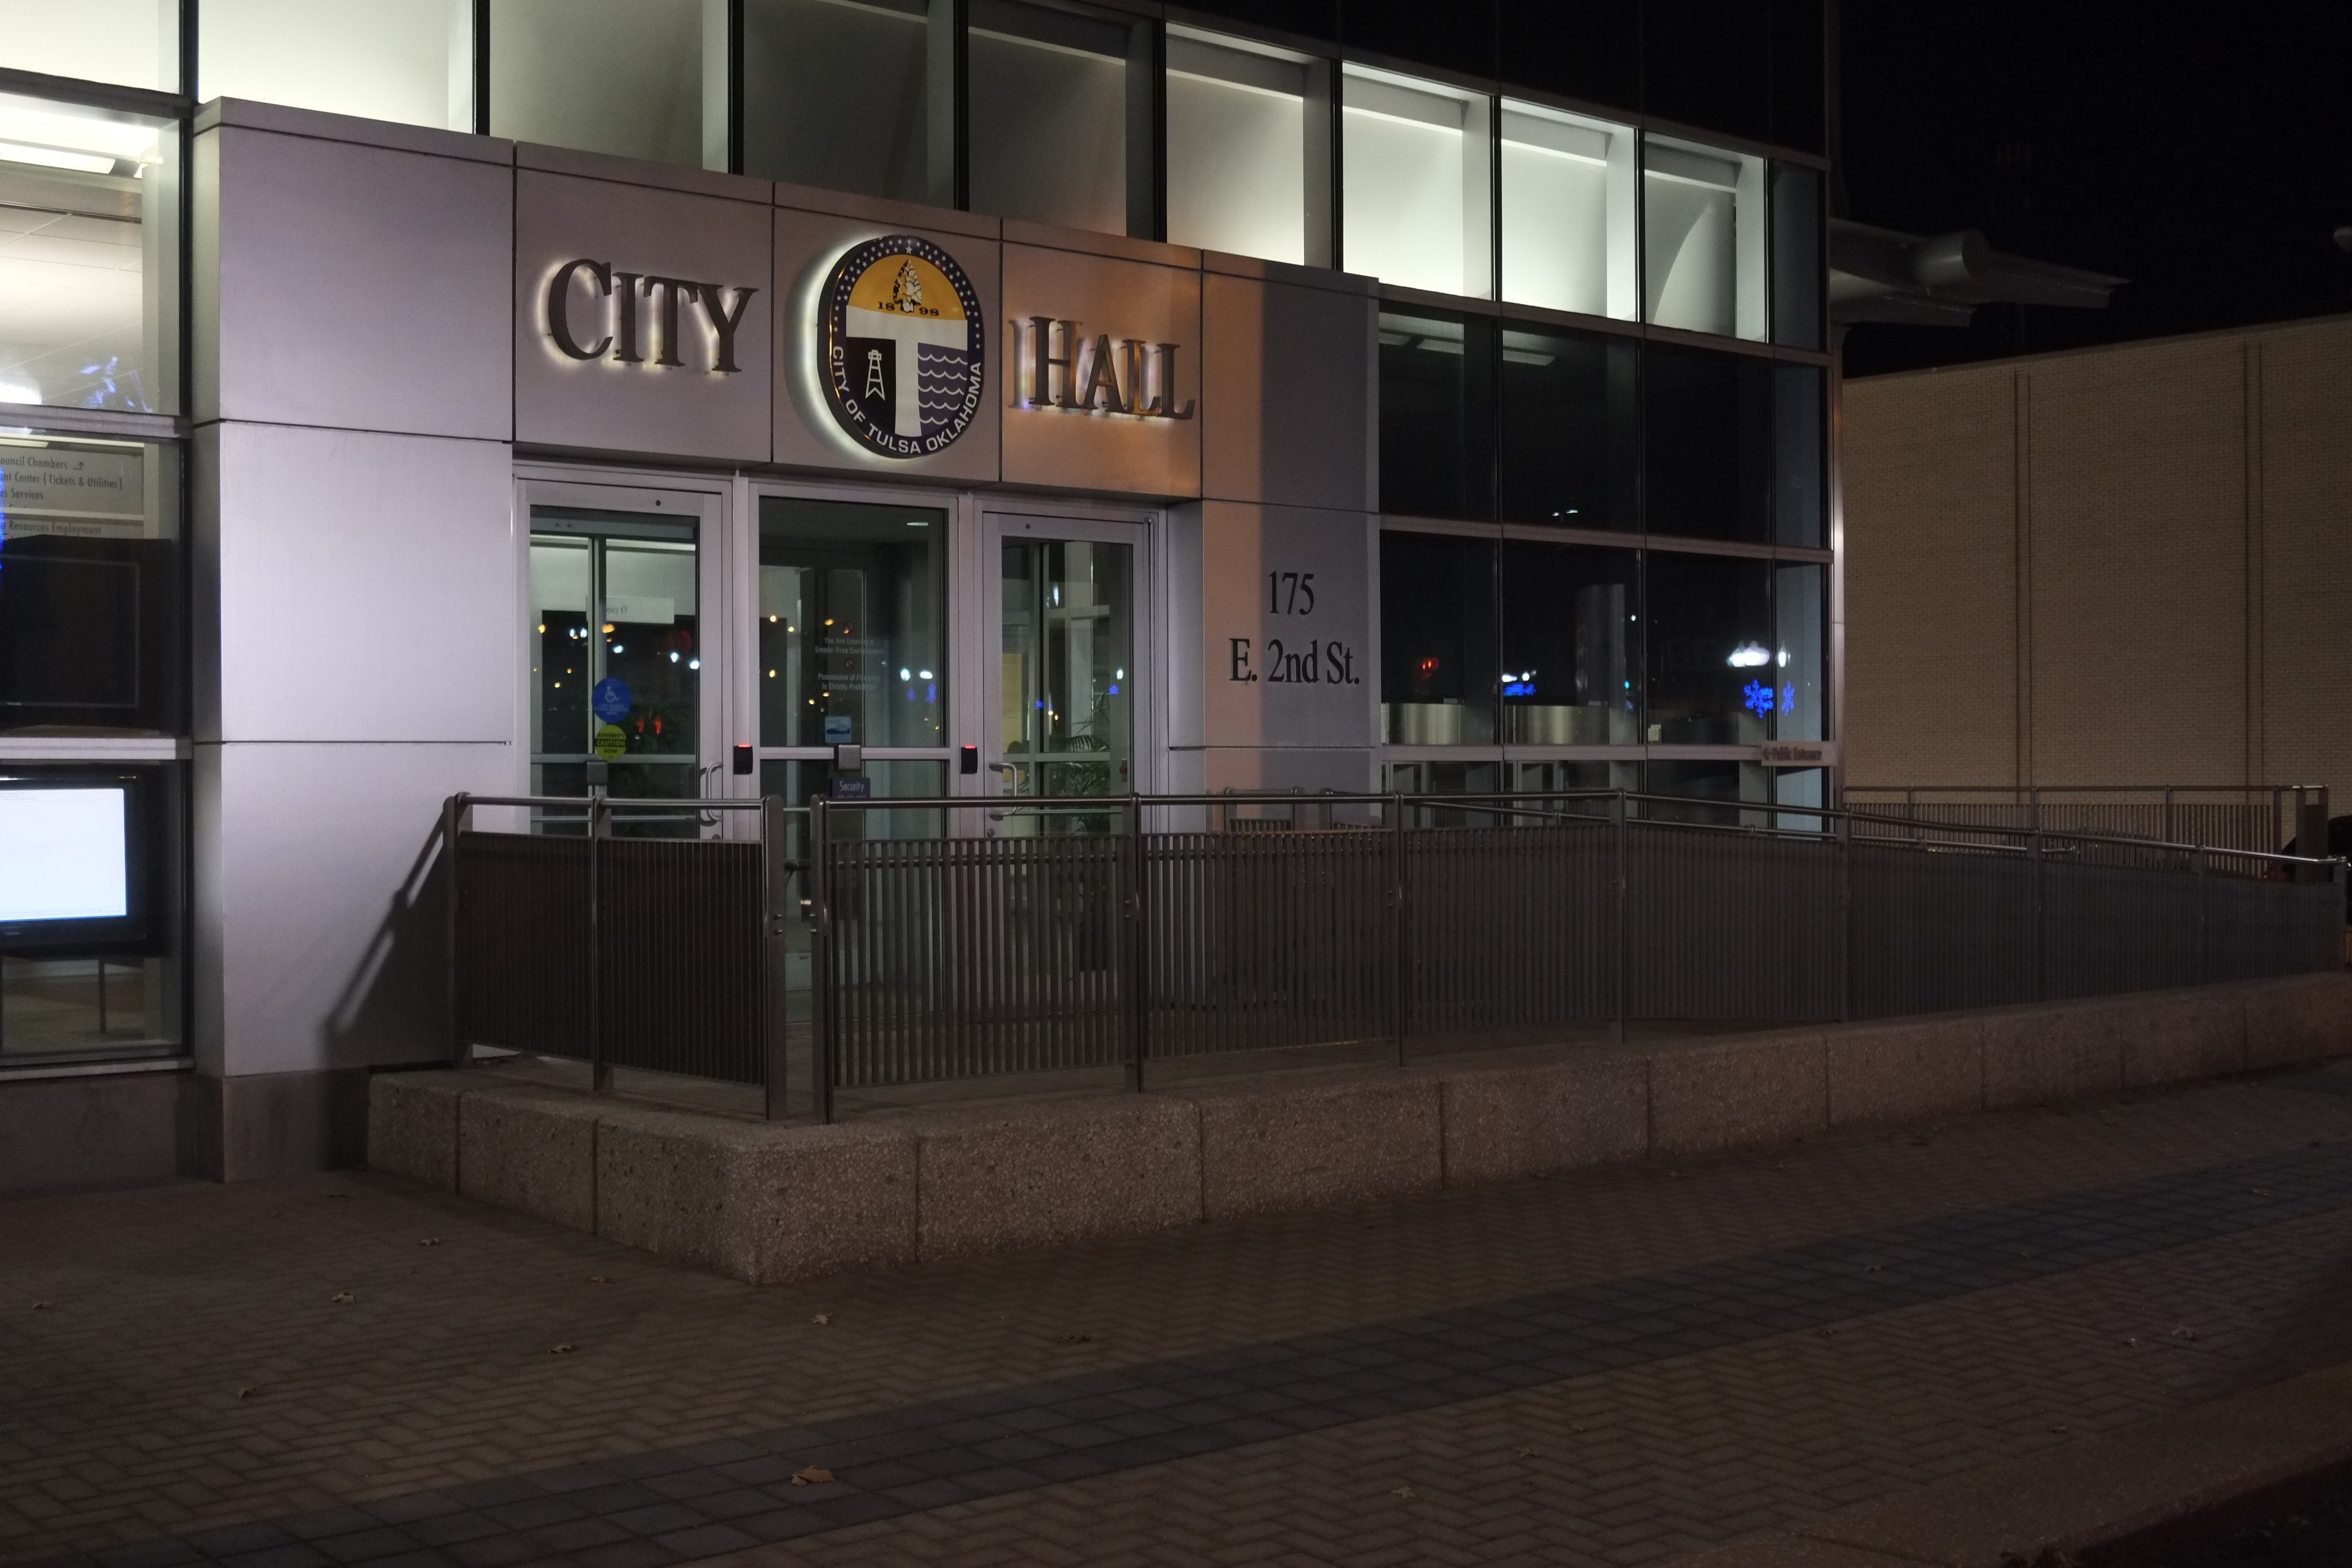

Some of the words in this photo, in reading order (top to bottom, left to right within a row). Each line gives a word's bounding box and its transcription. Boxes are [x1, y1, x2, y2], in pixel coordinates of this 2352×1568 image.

[877, 301, 895, 311] 18
[919, 307, 940, 317] 98
[548, 258, 759, 373] CITY
[1029, 316, 1195, 420] HALL
[832, 345, 850, 393] CITY
[845, 398, 866, 424] OF
[869, 423, 921, 454] TULSA
[926, 362, 981, 453] OKLAHOMA
[0, 456, 24, 466] ouncil
[28, 457, 68, 469] Chambers
[15, 472, 40, 483] Center
[79, 477, 85, 486] &
[11, 488, 44, 500] Services
[10, 520, 49, 532] Resources
[52, 523, 101, 536] Employment
[1269, 571, 1314, 615] 175
[1229, 638, 1258, 682] E.
[1267, 639, 1320, 683] 2nd
[1326, 641, 1360, 684] St.
[839, 781, 864, 793] Security
